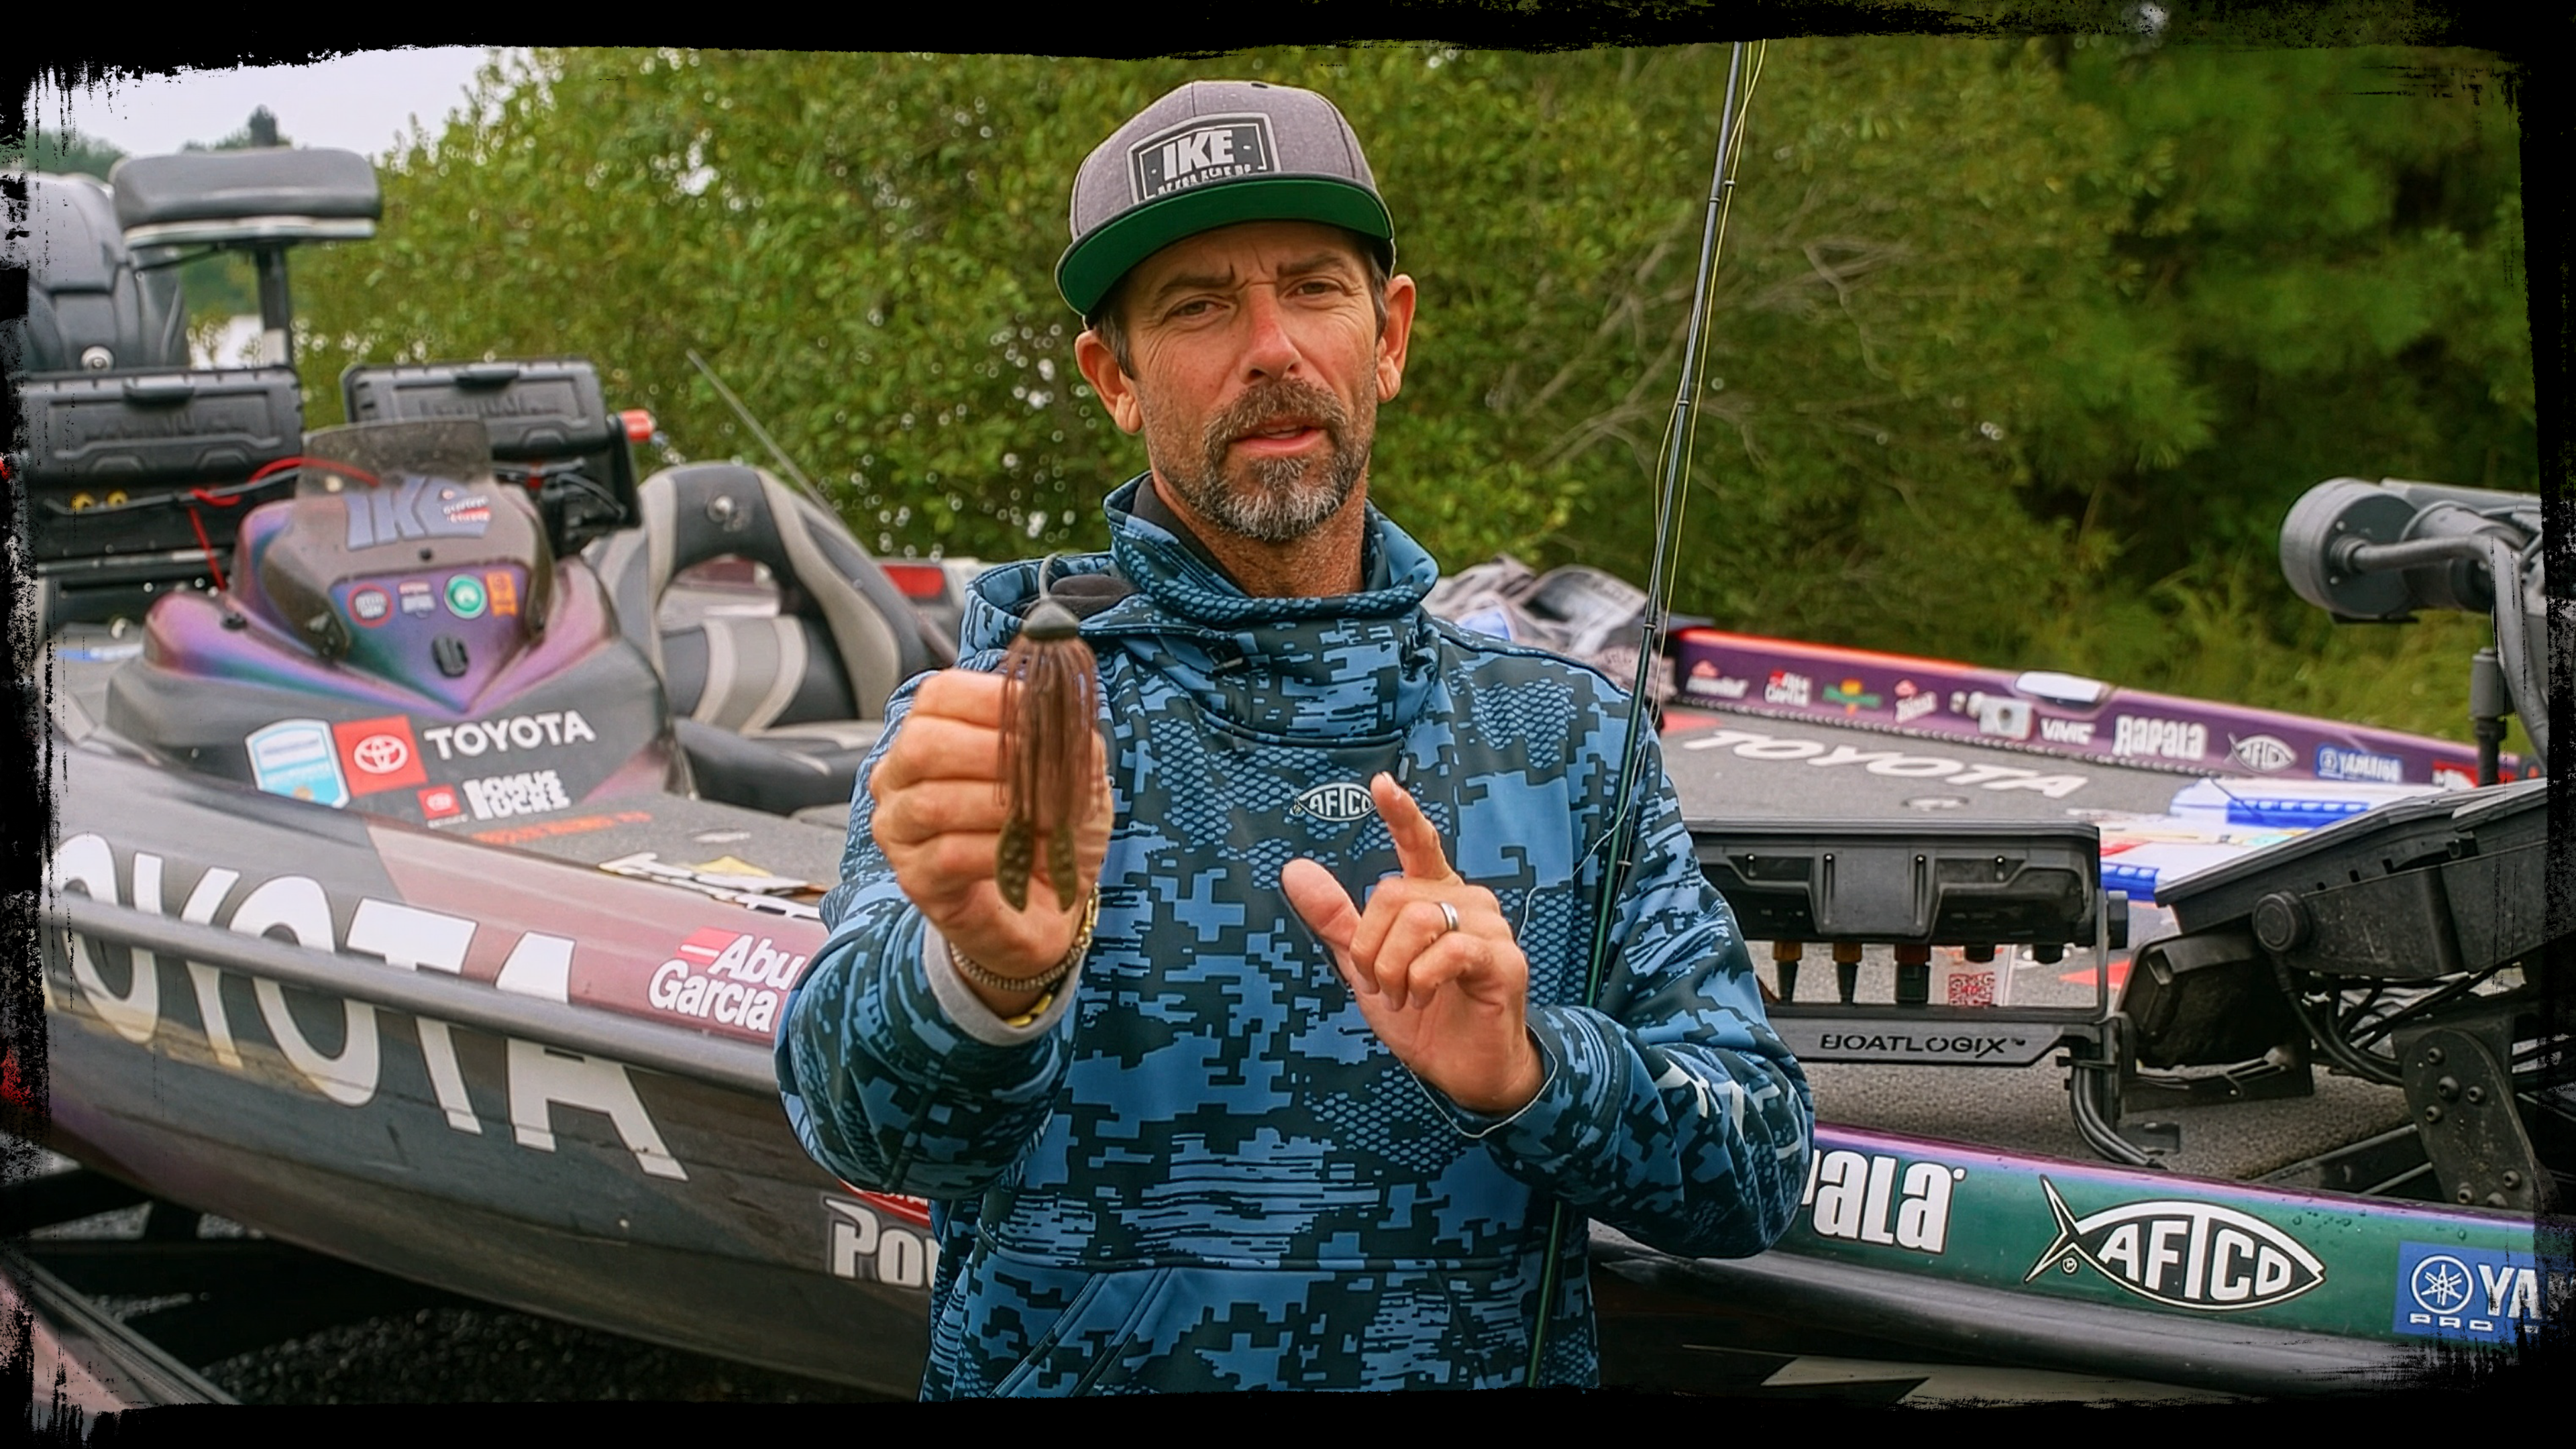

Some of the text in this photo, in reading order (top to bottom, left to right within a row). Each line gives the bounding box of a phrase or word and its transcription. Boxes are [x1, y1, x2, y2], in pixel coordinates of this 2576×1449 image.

[1163, 129, 1235, 181] IKE
[423, 710, 596, 760] TOYOTA
[1682, 729, 2089, 799] TOYOTA
[2111, 714, 2209, 761] Rapala
[706, 934, 807, 991] Abu
[41, 833, 690, 1183] OYOTA
[648, 959, 780, 1033] Garcia
[2097, 1213, 2292, 1301] AFTCO
